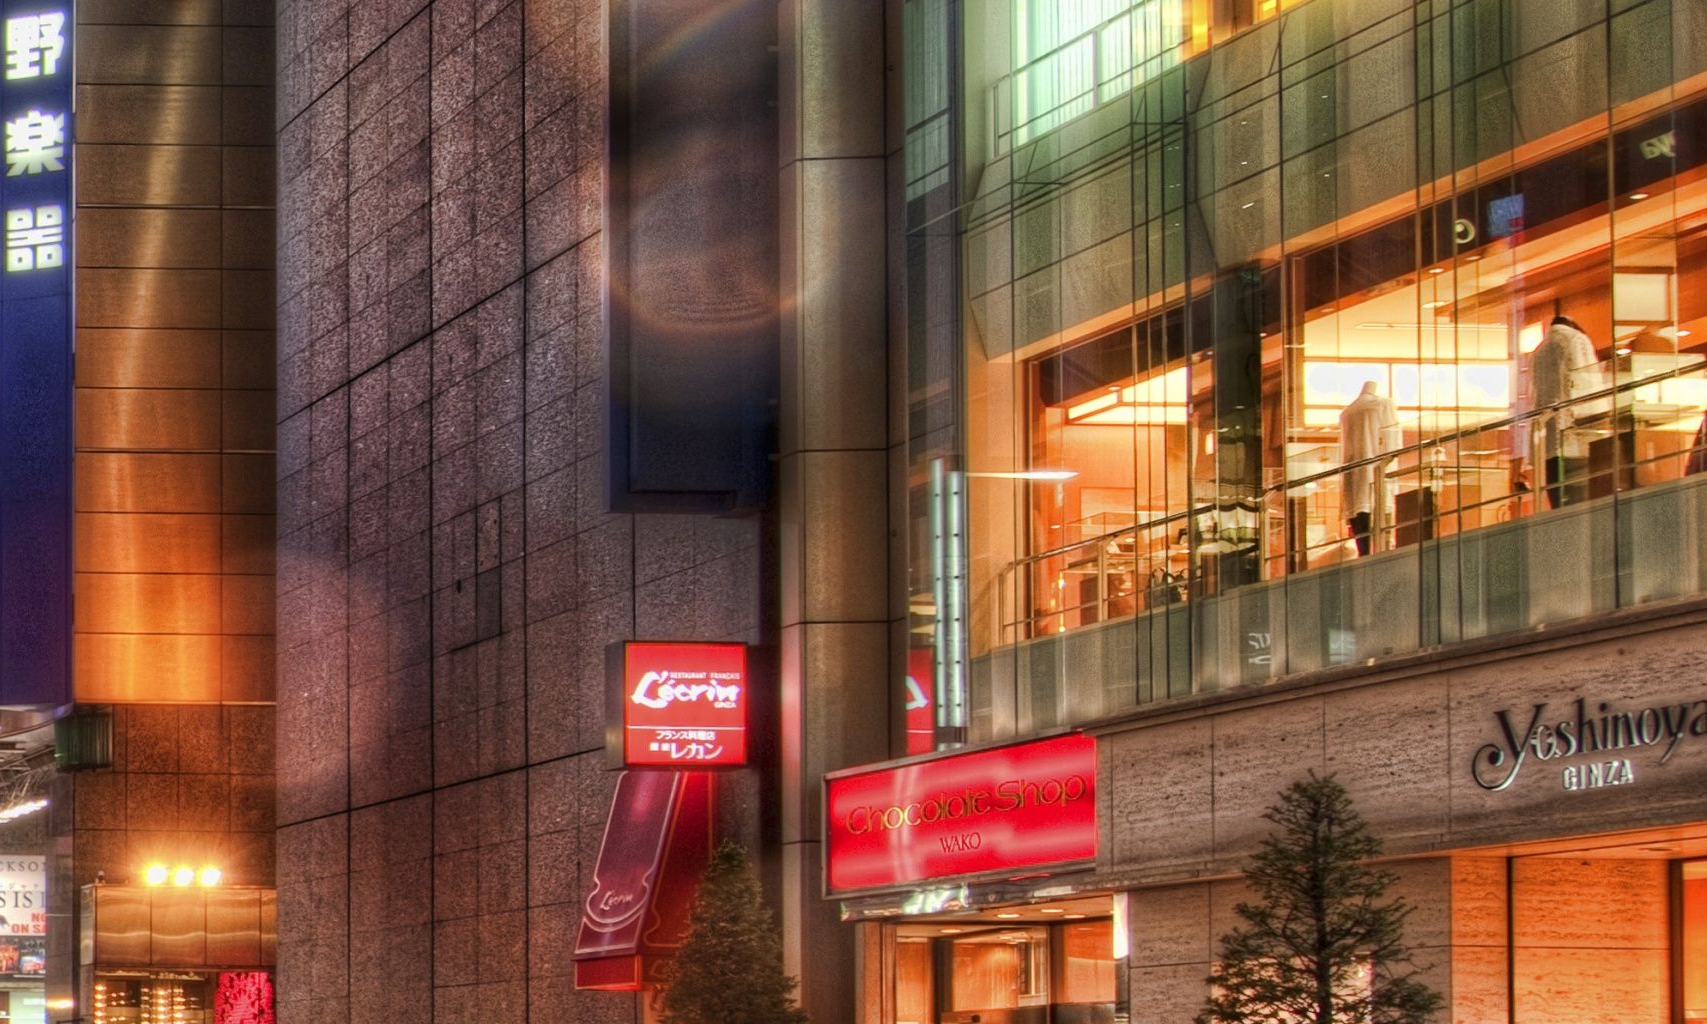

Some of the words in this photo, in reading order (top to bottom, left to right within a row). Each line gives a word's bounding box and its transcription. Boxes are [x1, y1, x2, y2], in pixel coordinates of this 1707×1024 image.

[5, 11, 66, 272] 野楽器
[1472, 697, 1707, 791] Yoshinoya
[1563, 759, 1635, 791] GINZA
[846, 781, 992, 835] Chocolate
[996, 775, 1087, 813] Shop
[939, 831, 982, 854] WAKO
[14, 890, 33, 909] IS
[11, 924, 29, 934] ON
